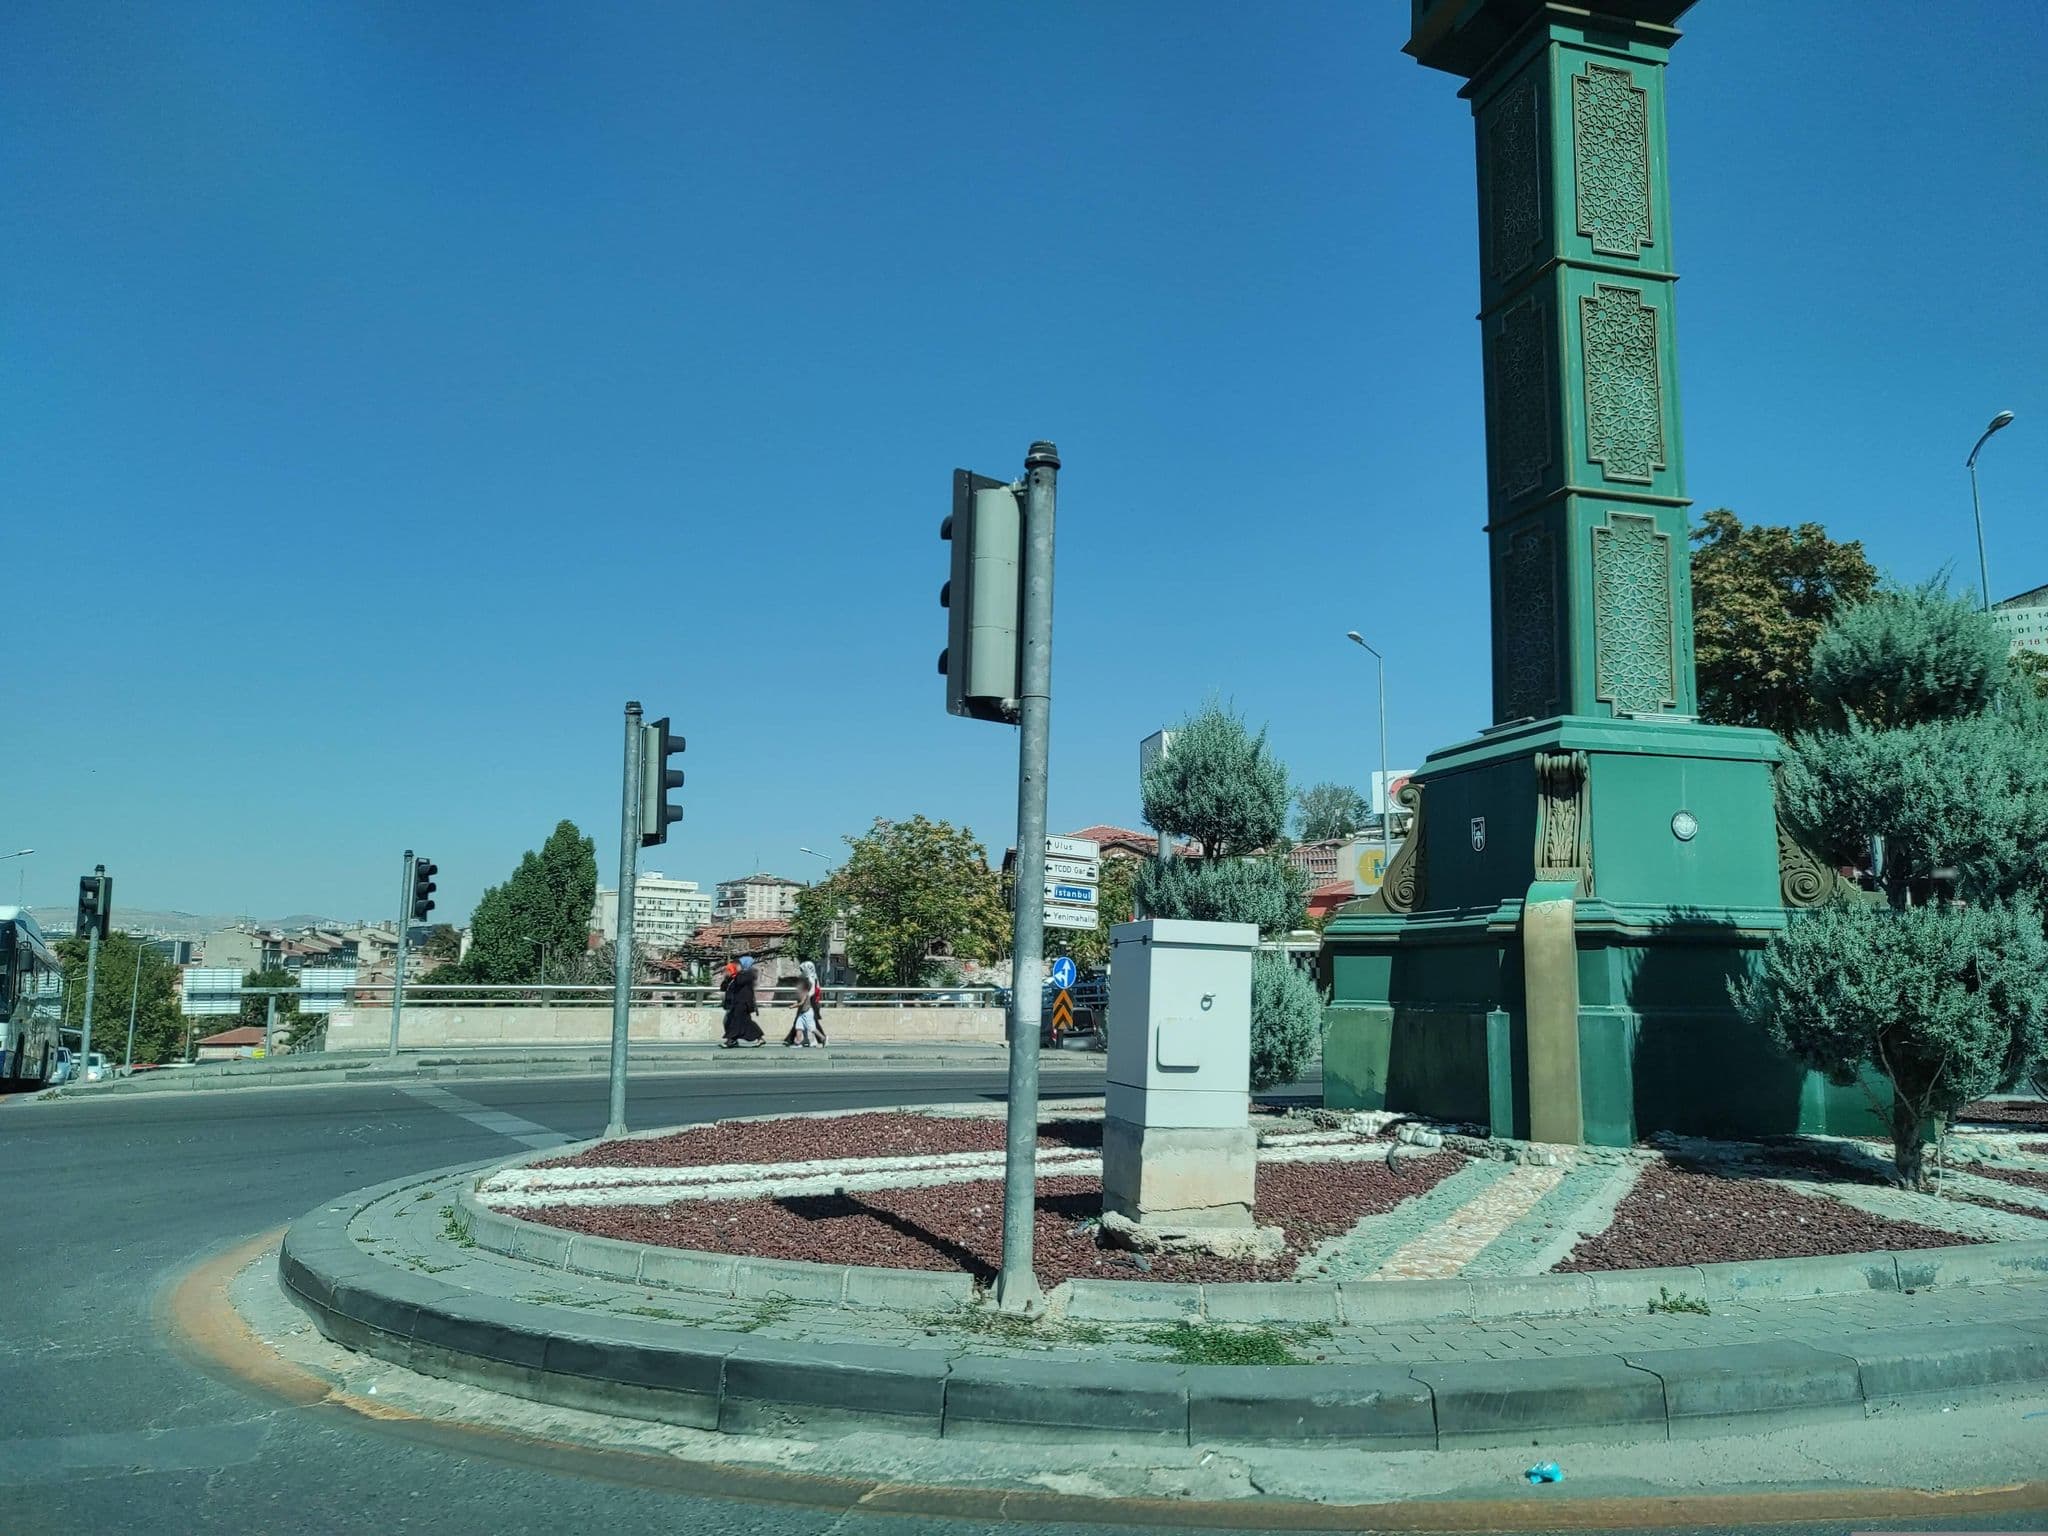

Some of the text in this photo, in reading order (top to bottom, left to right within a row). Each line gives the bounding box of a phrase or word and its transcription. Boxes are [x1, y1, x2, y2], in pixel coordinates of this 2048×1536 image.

[1054, 841, 1073, 850] Ulus
[1054, 864, 1087, 875] TCDD Gar
